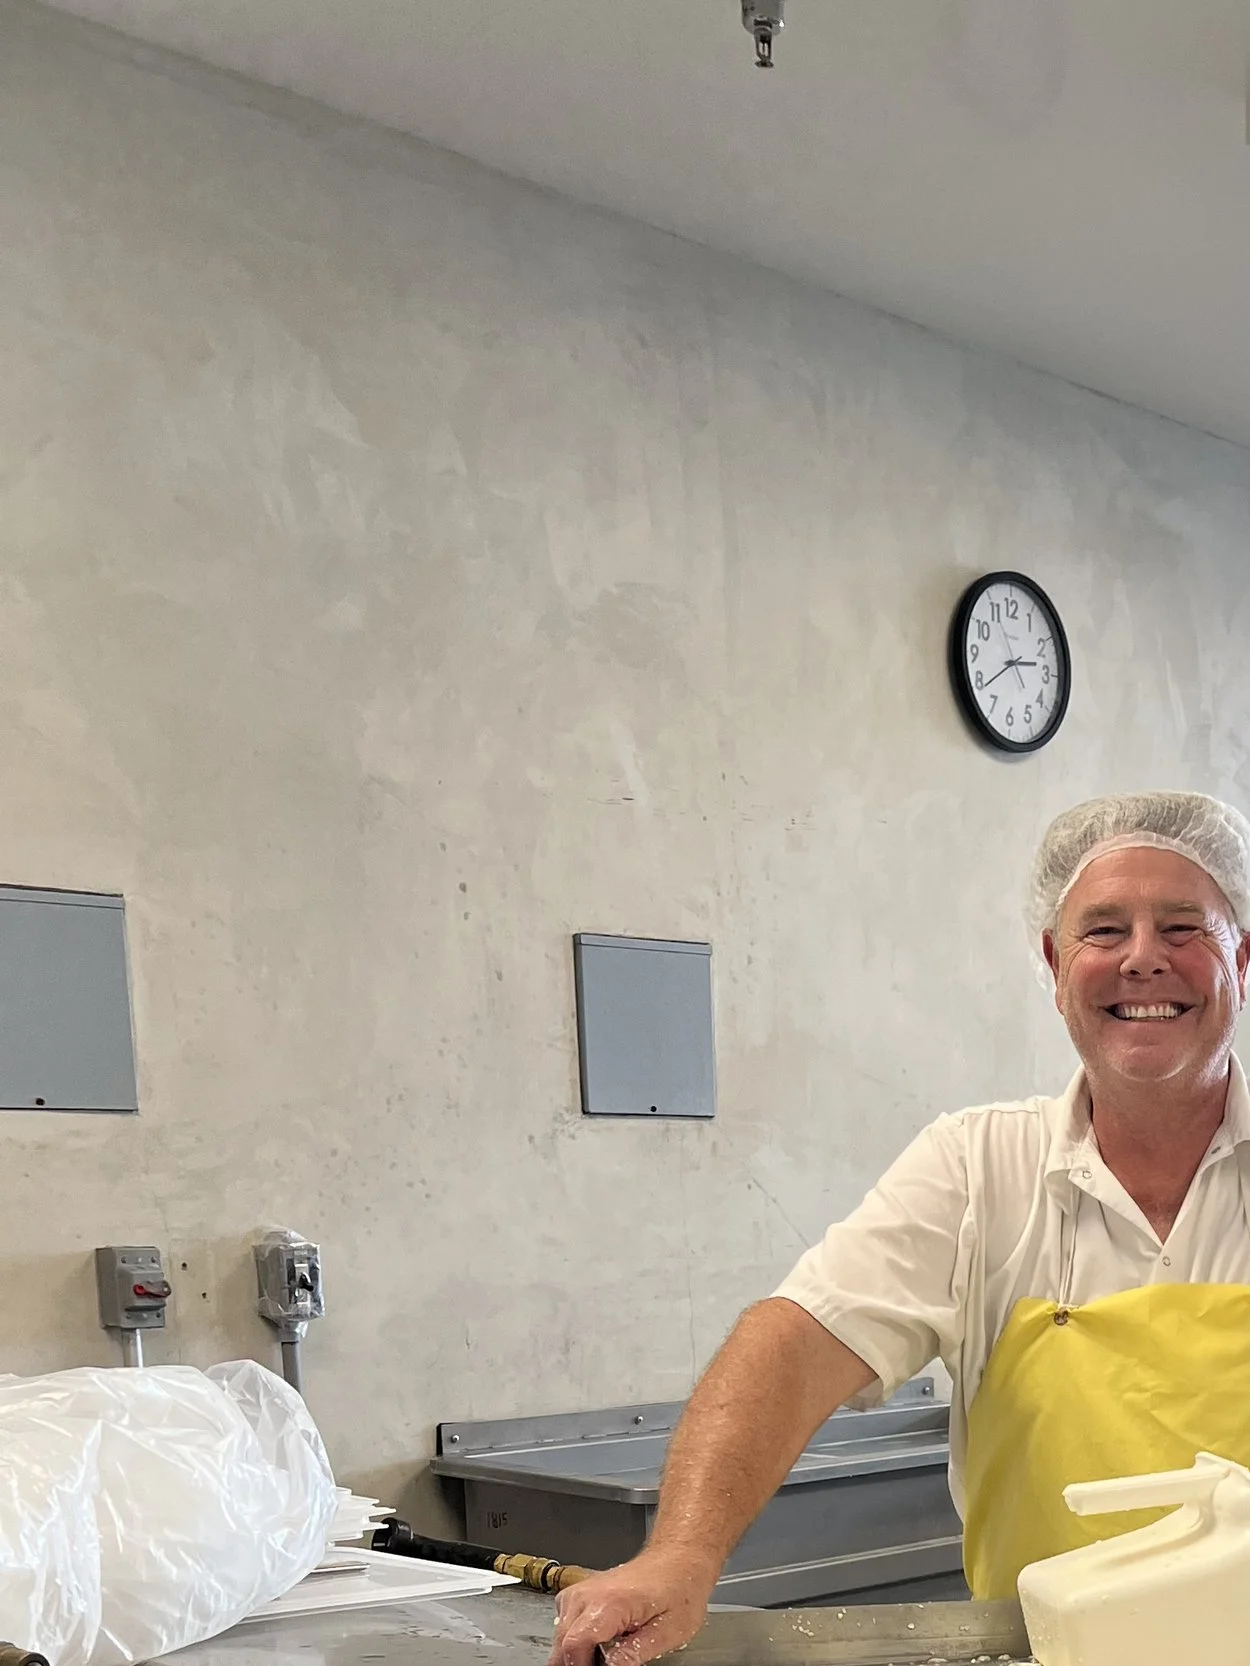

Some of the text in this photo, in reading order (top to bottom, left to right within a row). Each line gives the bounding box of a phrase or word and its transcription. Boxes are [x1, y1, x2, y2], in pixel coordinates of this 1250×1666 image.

[989, 601, 1001, 623] 11
[1004, 598, 1019, 620] 12
[976, 619, 990, 641] 10
[1026, 613, 1032, 632] 1
[970, 644, 979, 663] 9
[1037, 638, 1046, 658] 2
[975, 670, 984, 691] 8
[1041, 665, 1050, 684] 3
[989, 694, 998, 713] 7
[1035, 688, 1044, 708] 4
[1005, 707, 1014, 727] 6
[1023, 704, 1032, 724] 5
